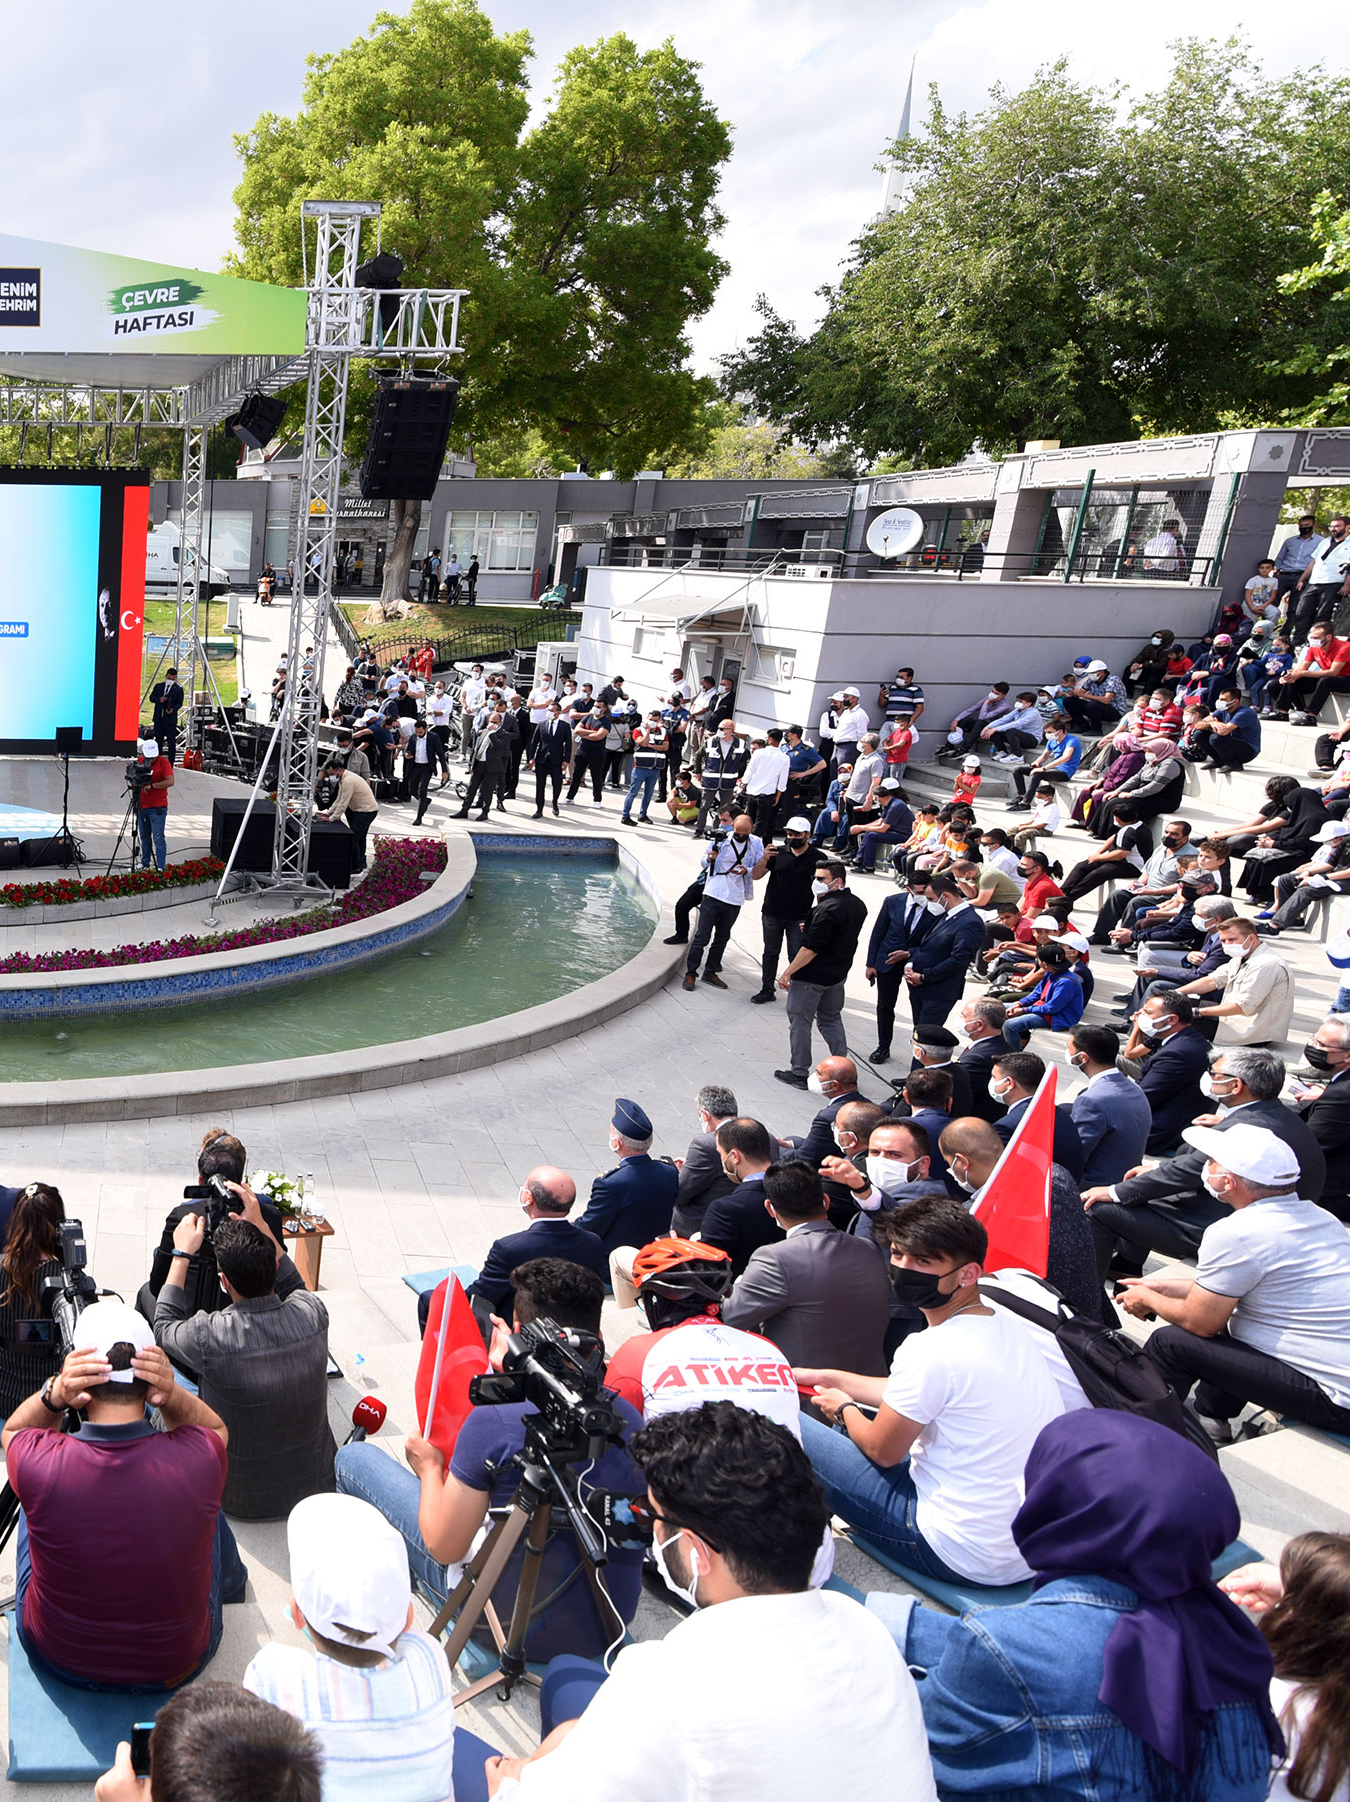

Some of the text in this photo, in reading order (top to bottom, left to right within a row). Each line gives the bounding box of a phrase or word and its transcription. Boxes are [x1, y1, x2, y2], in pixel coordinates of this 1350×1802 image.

[121, 286, 180, 311] ÇEVRE
[114, 311, 194, 335] HAFTASI
[344, 498, 372, 508] Millet
[359, 1402, 380, 1419] DHA
